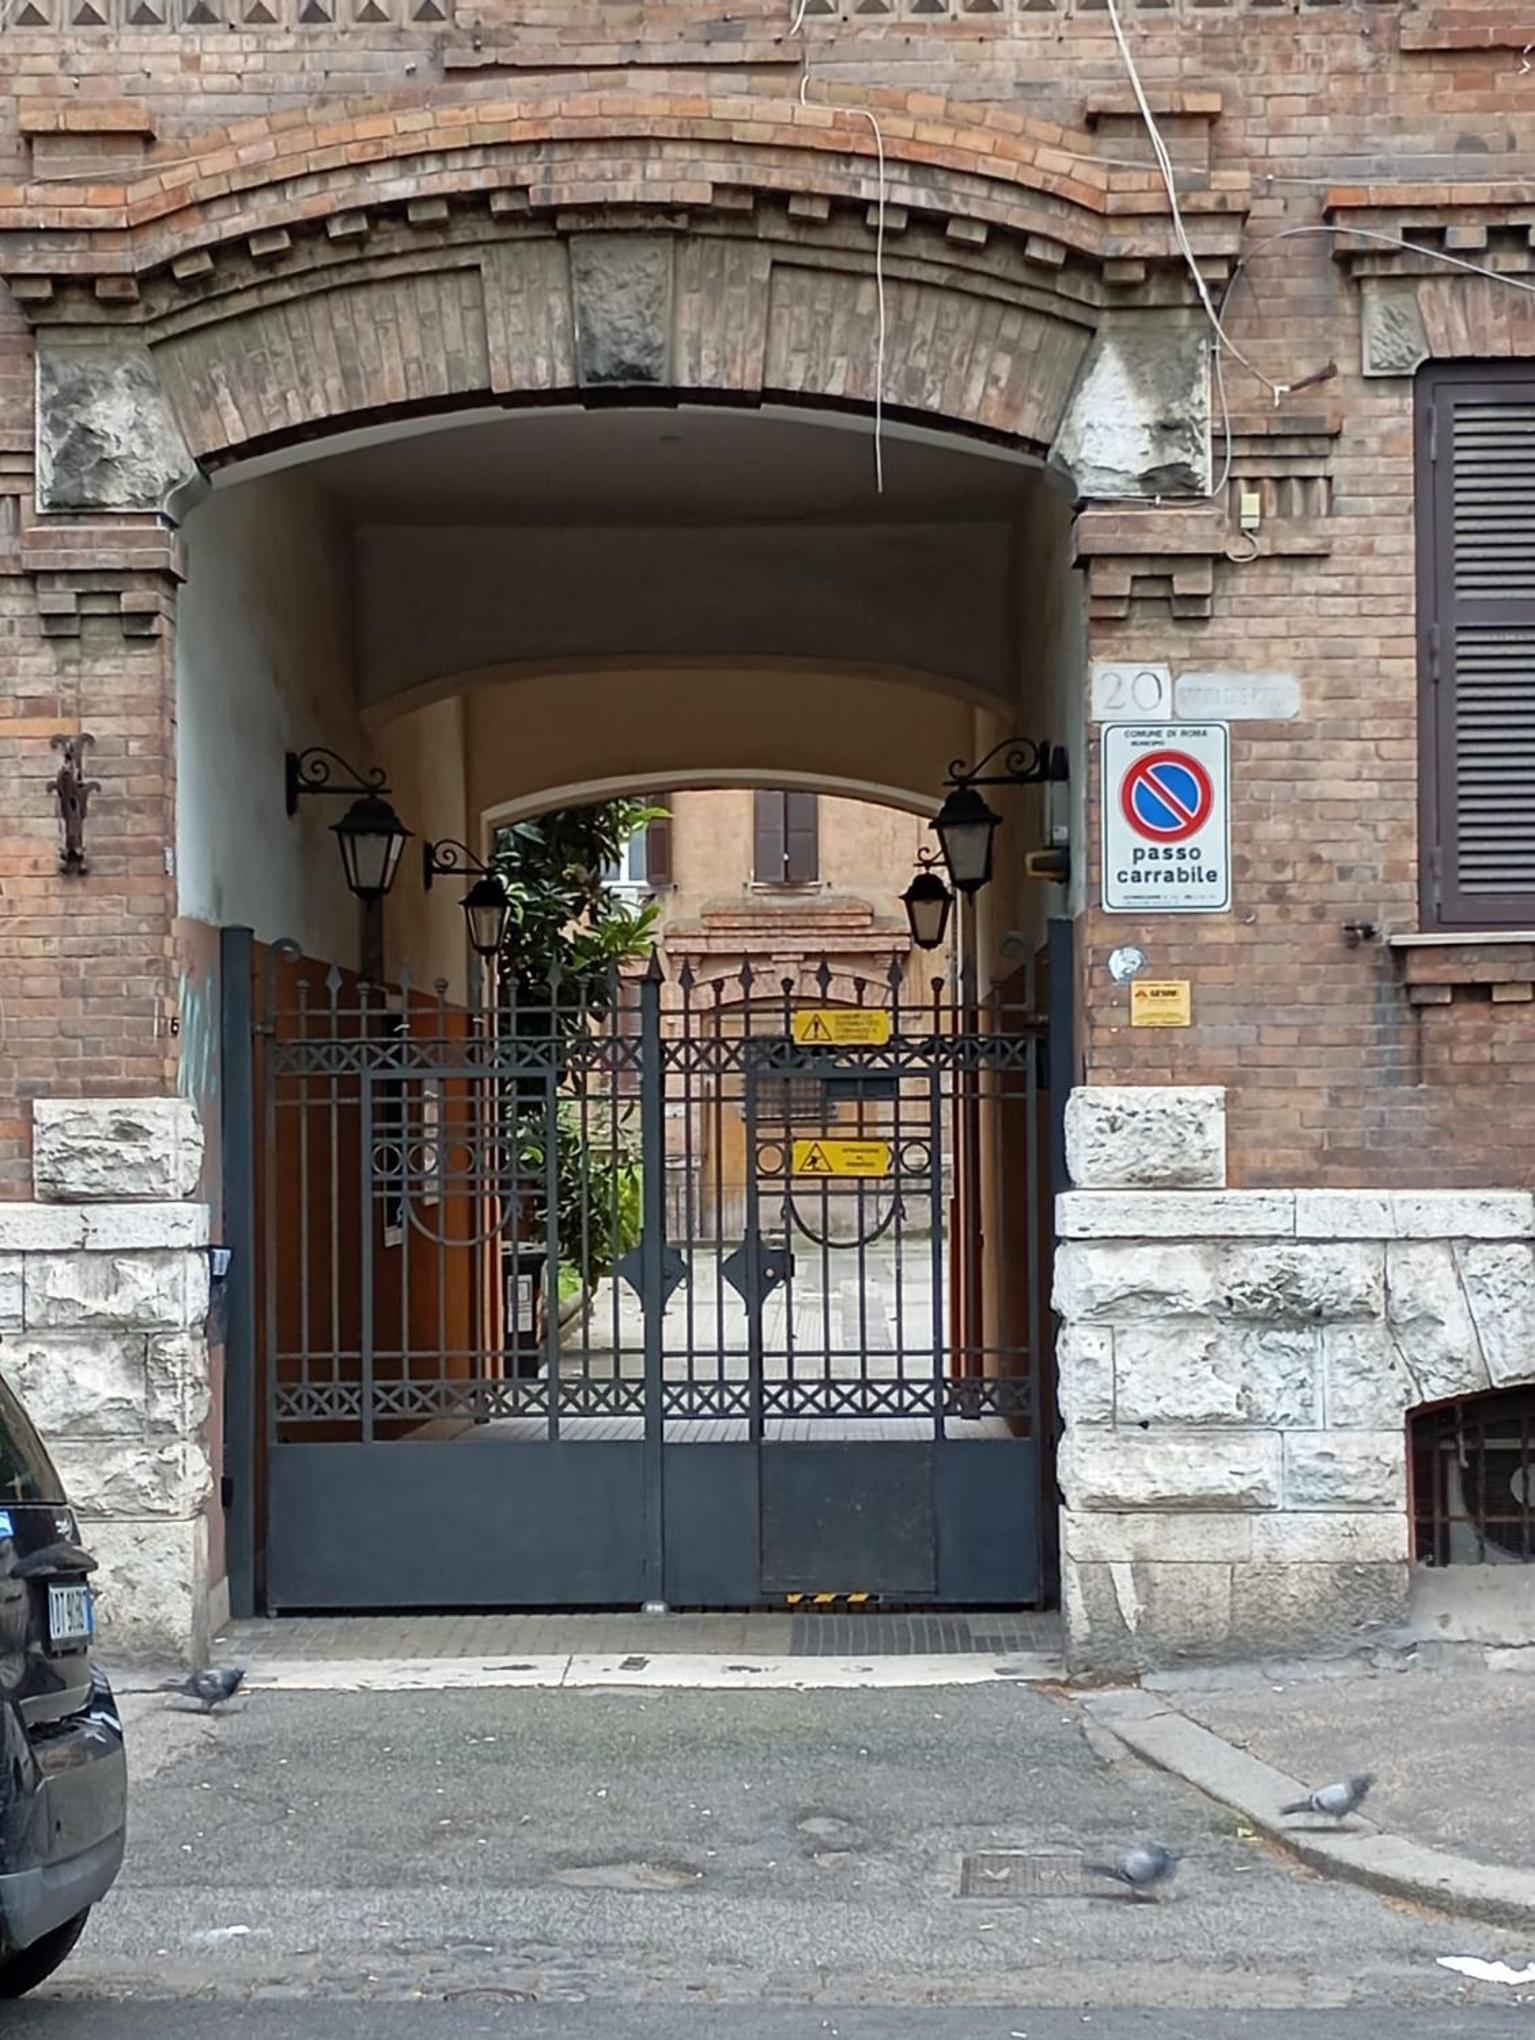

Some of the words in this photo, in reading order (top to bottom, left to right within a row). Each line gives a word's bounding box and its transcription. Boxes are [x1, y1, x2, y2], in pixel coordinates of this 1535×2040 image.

[1100, 671, 1162, 711] 20
[1123, 729, 1163, 738] COMUNE
[1166, 729, 1177, 738] DI
[1180, 729, 1208, 738] ROMA
[1132, 847, 1202, 865] passo
[1116, 866, 1218, 883] carrabile
